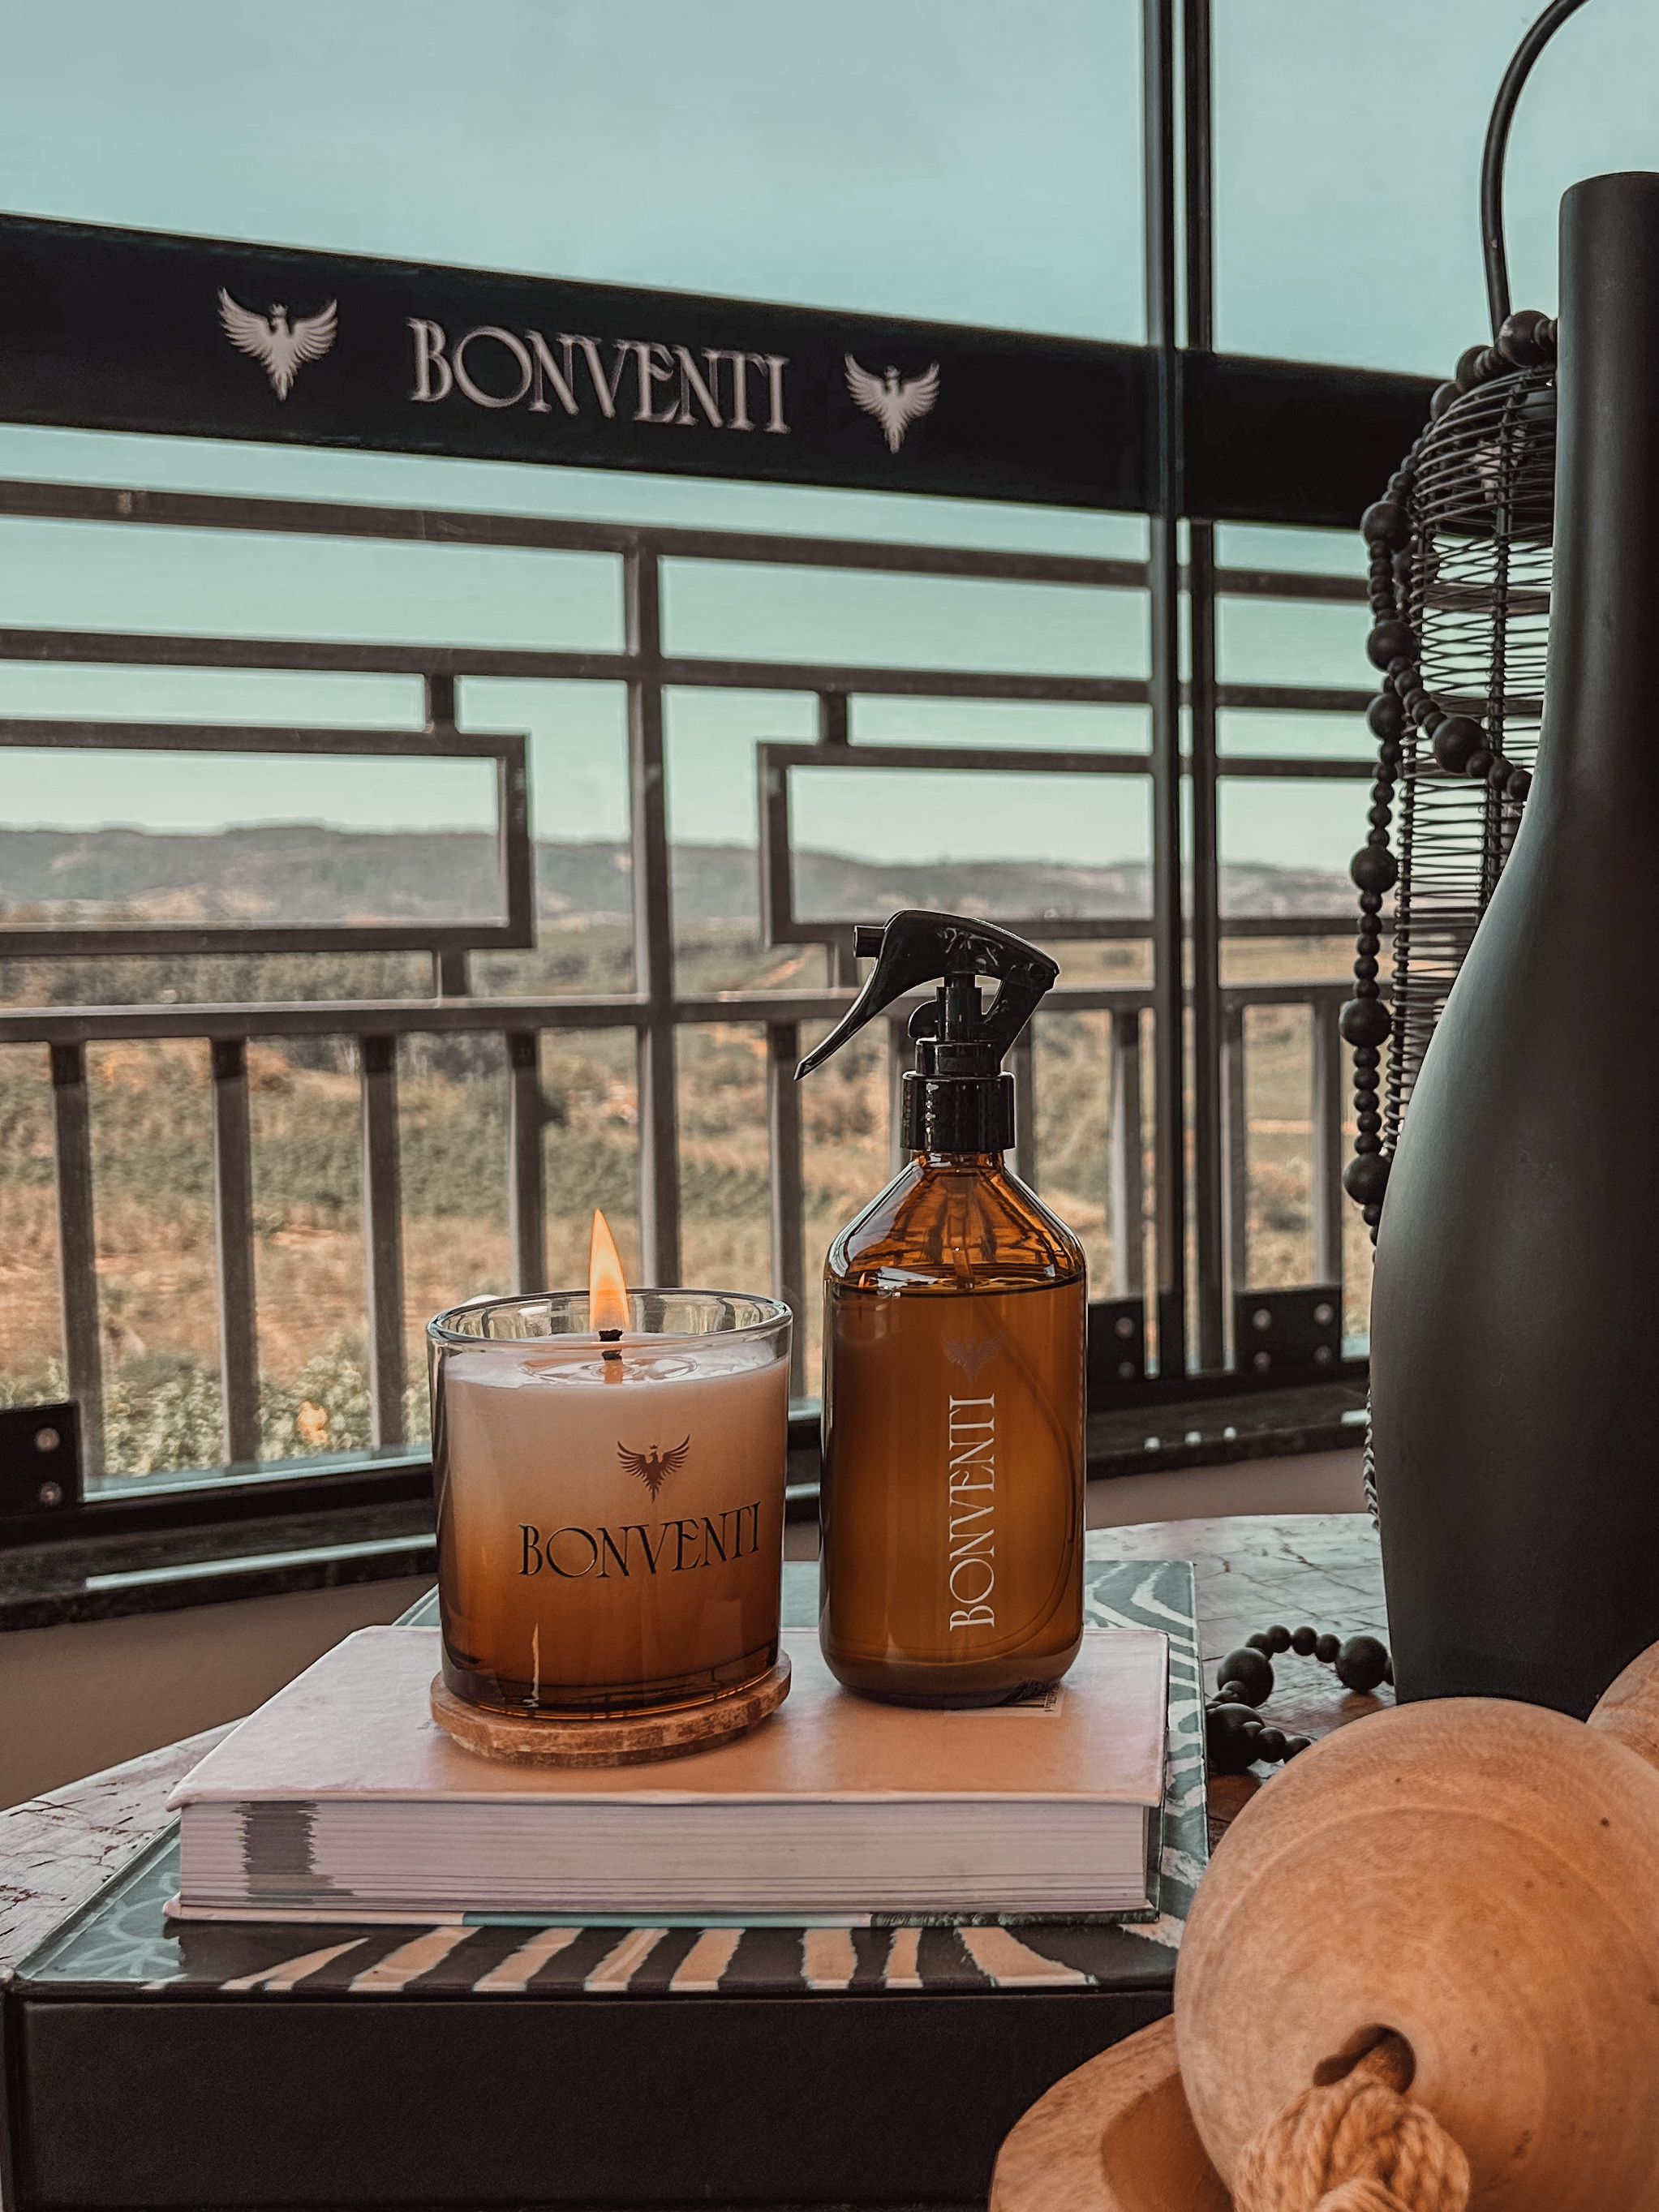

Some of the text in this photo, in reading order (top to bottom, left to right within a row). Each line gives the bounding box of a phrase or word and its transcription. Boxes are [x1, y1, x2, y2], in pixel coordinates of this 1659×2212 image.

[407, 317, 790, 433] BONVENTI
[518, 1501, 761, 1578] BONVENTI
[949, 1393, 995, 1631] BONVENTI
